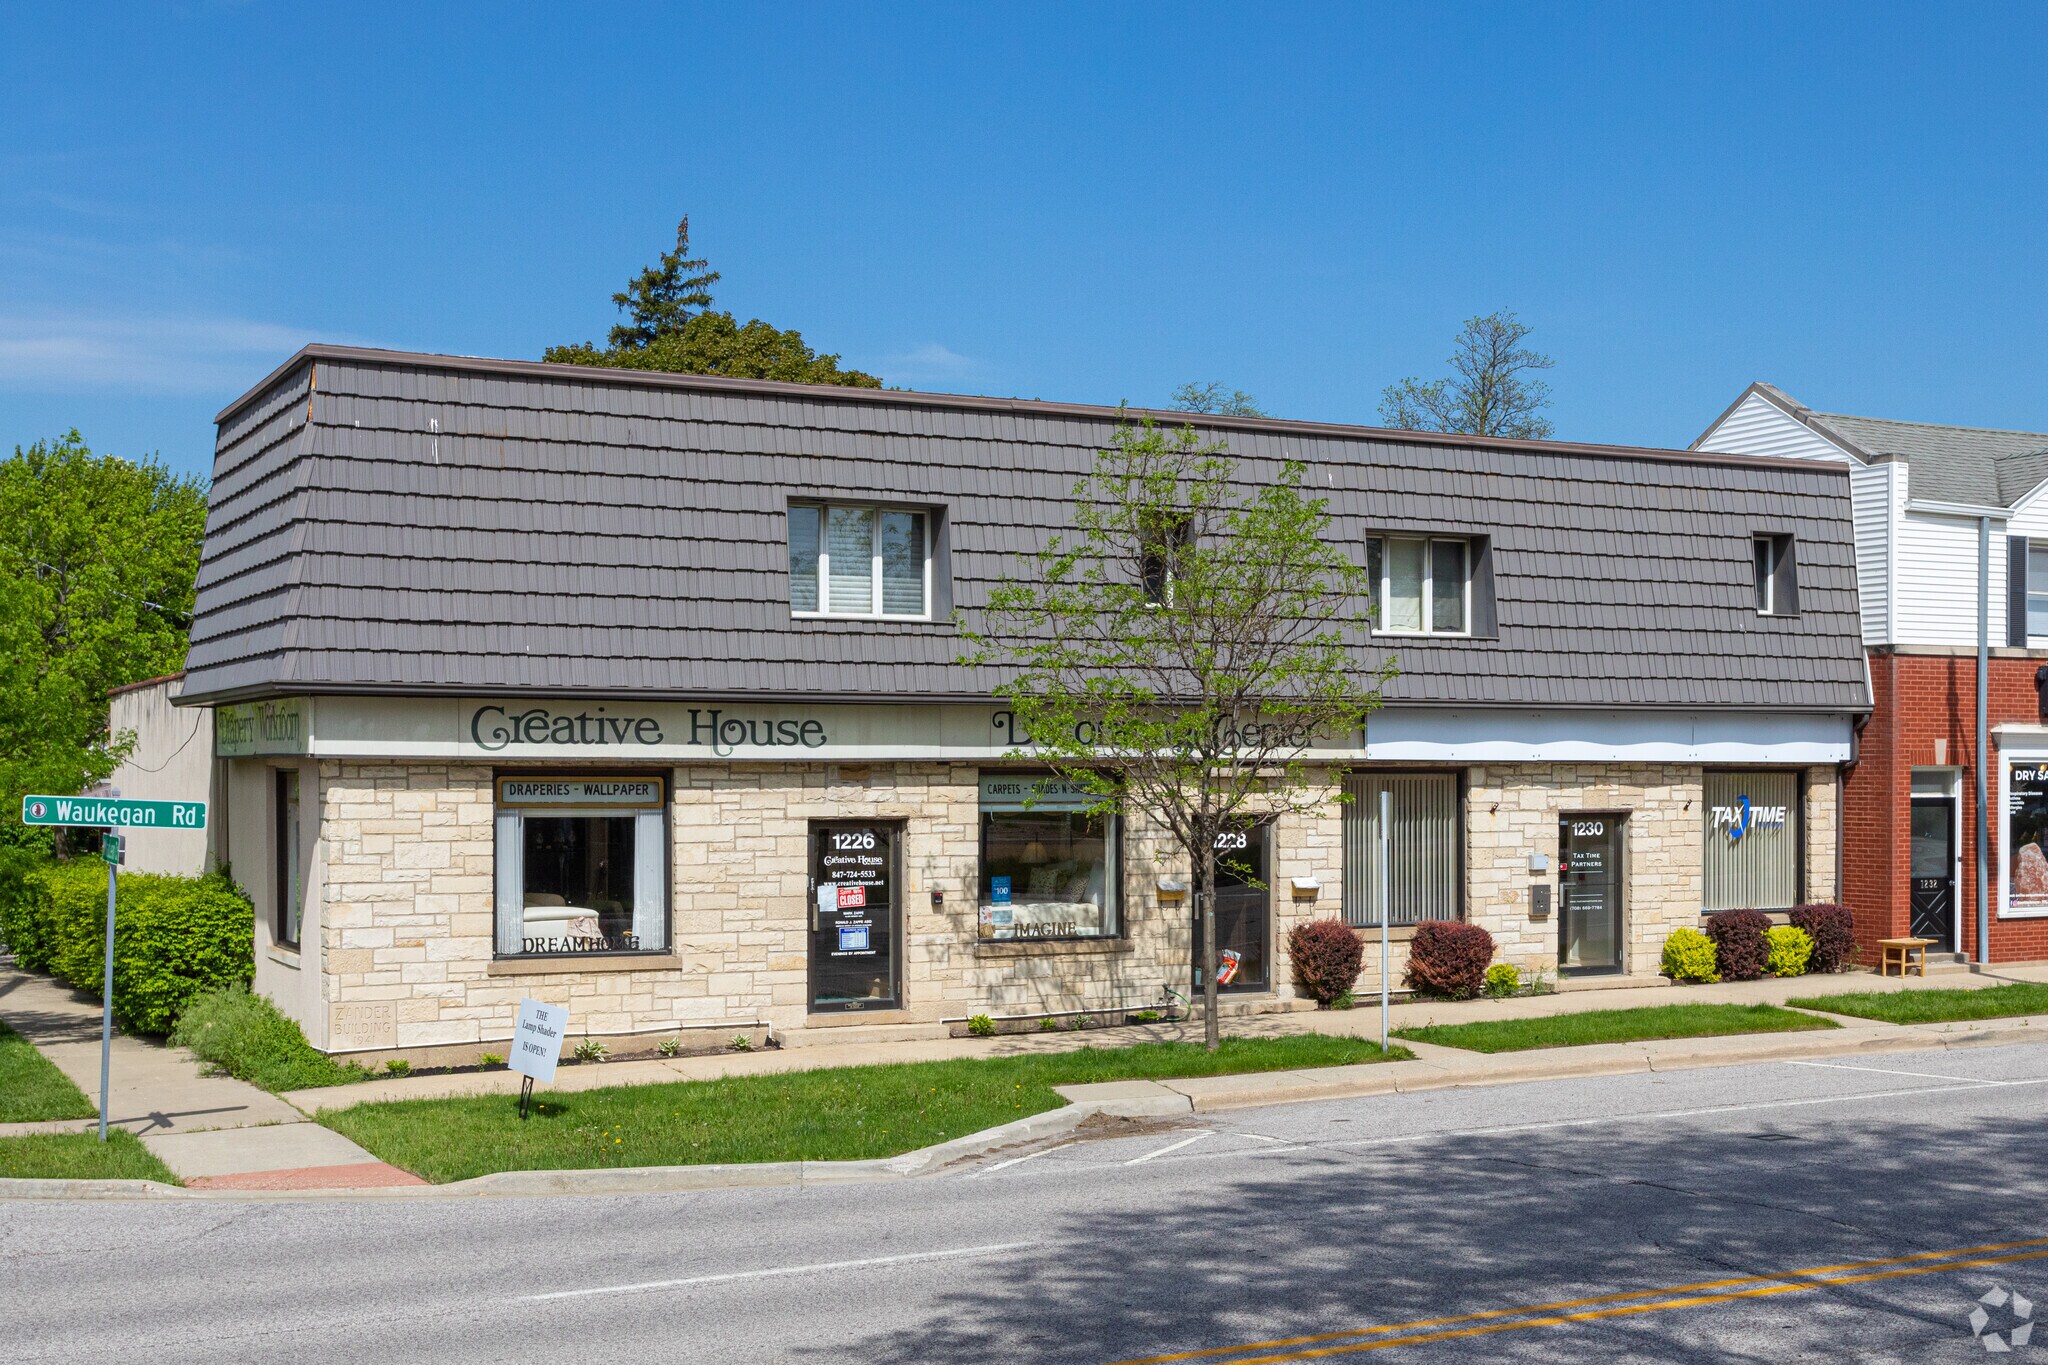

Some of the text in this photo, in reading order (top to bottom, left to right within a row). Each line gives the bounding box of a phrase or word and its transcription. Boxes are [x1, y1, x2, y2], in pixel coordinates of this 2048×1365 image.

[471, 706, 827, 757] Creative House
[2015, 770, 2036, 781] DRY
[509, 783, 570, 796] DRAPERIES
[584, 783, 649, 796] WALLPAPER
[987, 783, 1021, 795] CARPETS
[56, 800, 196, 827] Waukegan Rd
[1712, 805, 1787, 831] TAX TIME
[1572, 822, 1604, 836] 1230
[832, 833, 875, 850] 1226
[824, 855, 883, 867] Creative House
[832, 870, 876, 878] 847-724-5533
[1920, 879, 1938, 889] 1232
[840, 894, 863, 906] CLOSED
[1014, 921, 1077, 938] IMAGINE
[335, 1006, 391, 1021] ZANDER
[536, 1010, 549, 1022] THE
[522, 1019, 557, 1038] Lamp Shader
[522, 1041, 547, 1057] IS OPEN!
